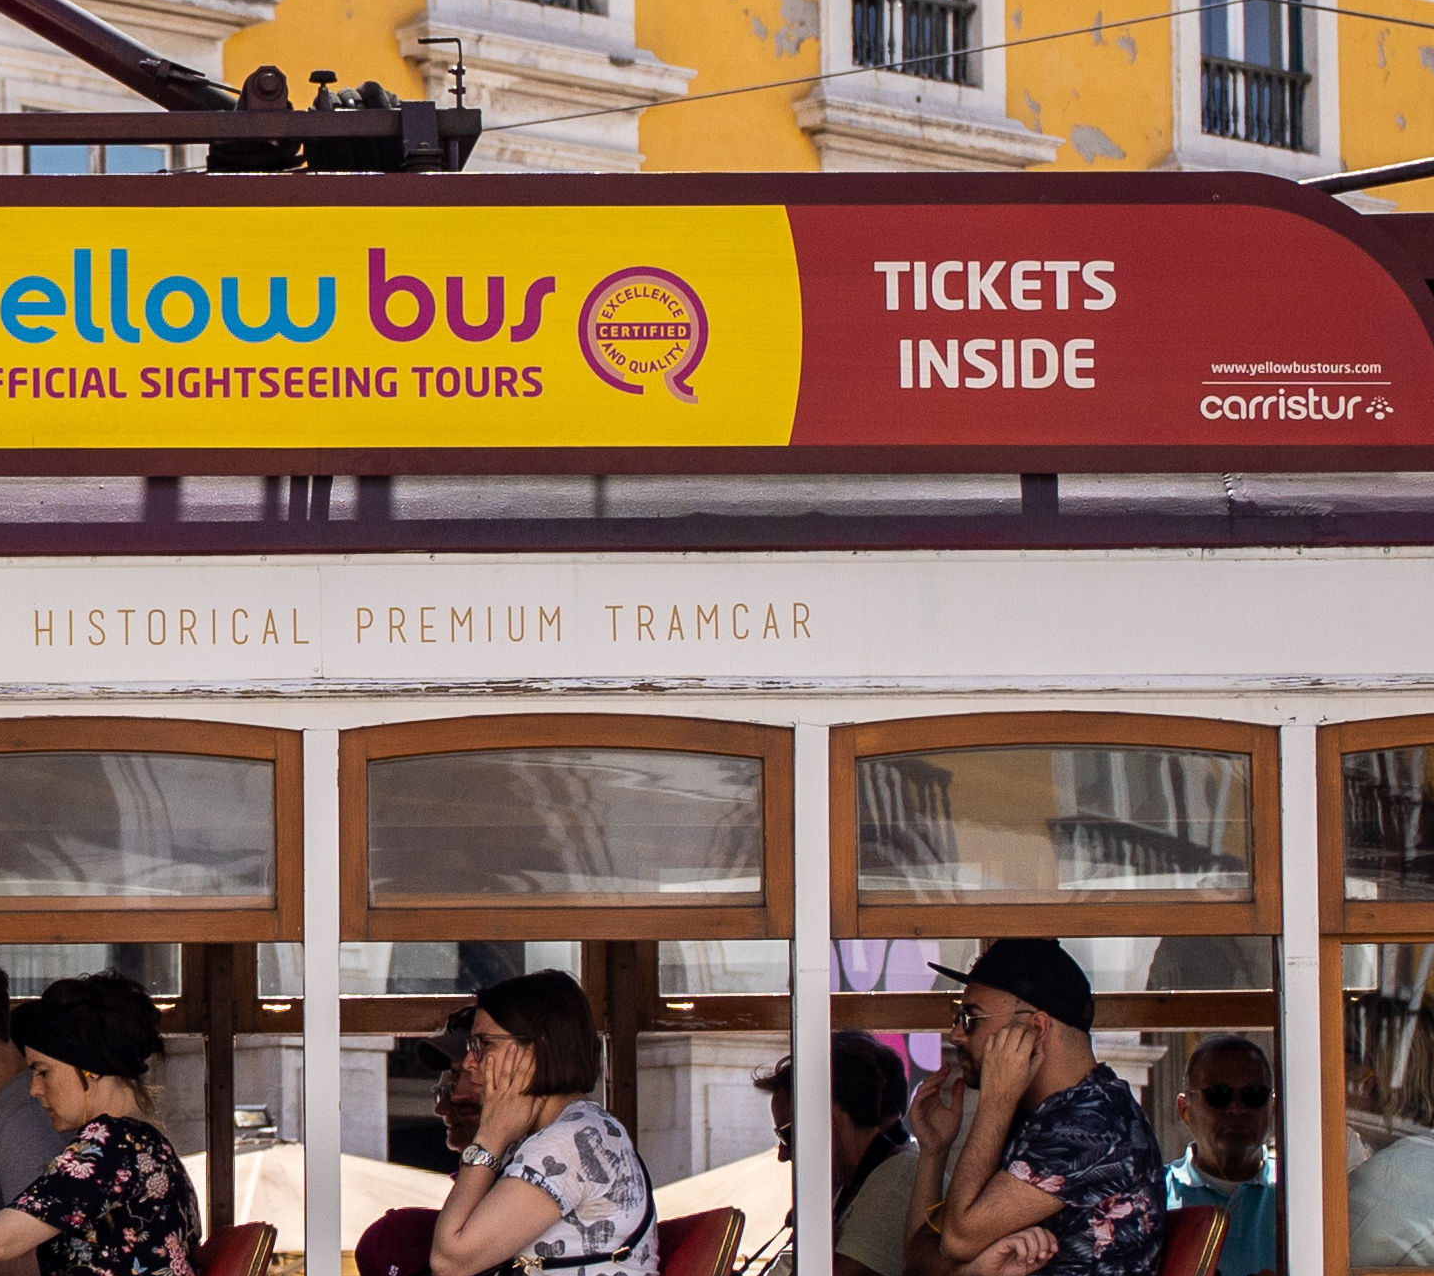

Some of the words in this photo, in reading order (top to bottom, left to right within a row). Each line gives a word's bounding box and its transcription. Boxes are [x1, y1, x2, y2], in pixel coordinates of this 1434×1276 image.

[368, 247, 556, 343] bus
[873, 260, 1117, 311] TICKETS
[601, 286, 684, 320] EXCELLENCE
[599, 325, 687, 338] CERTIFIED
[601, 342, 626, 366] AND
[629, 342, 684, 374] QUALITY
[899, 338, 1096, 389] INSIDE
[1210, 360, 1382, 377] www.yellowbustours.com
[140, 366, 398, 399] SIGHTSEEING
[411, 365, 543, 398] TOURS
[1199, 387, 1362, 420] carristur
[34, 608, 309, 647] HISTORICAL
[356, 605, 562, 644] PREMIUM
[605, 602, 812, 641] TRAMCAR
